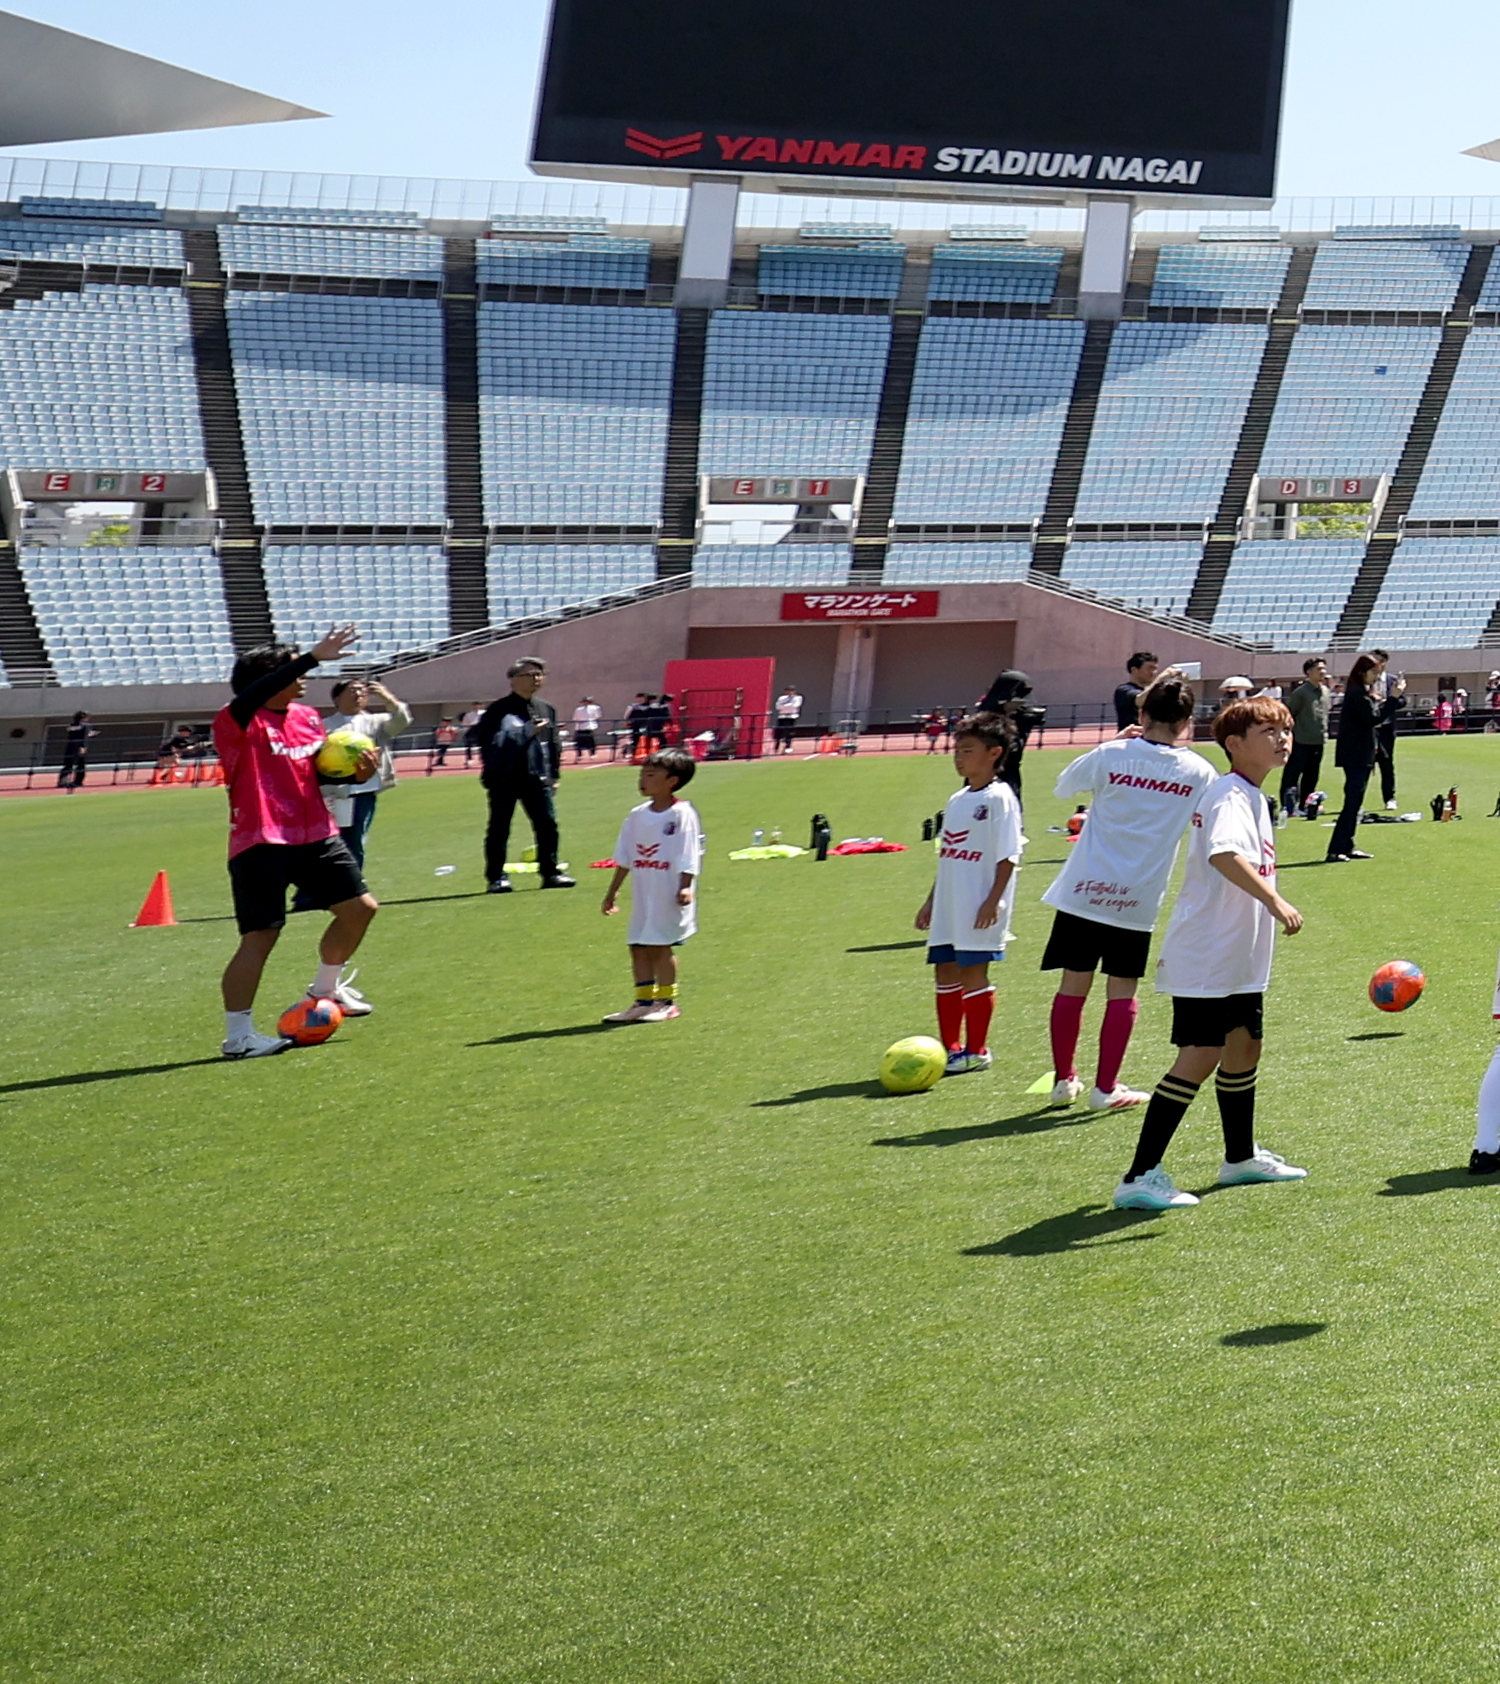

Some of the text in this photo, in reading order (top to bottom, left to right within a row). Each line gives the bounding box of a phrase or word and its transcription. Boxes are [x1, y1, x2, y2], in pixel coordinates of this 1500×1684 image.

[717, 135, 1203, 185] YANMAR STADIUM NAGAI
[49, 475, 161, 491] E 2
[736, 481, 824, 495] E 1
[1282, 481, 1355, 494] D 3
[804, 594, 918, 610] マラソンゲート
[1108, 772, 1192, 798] YANMAR
